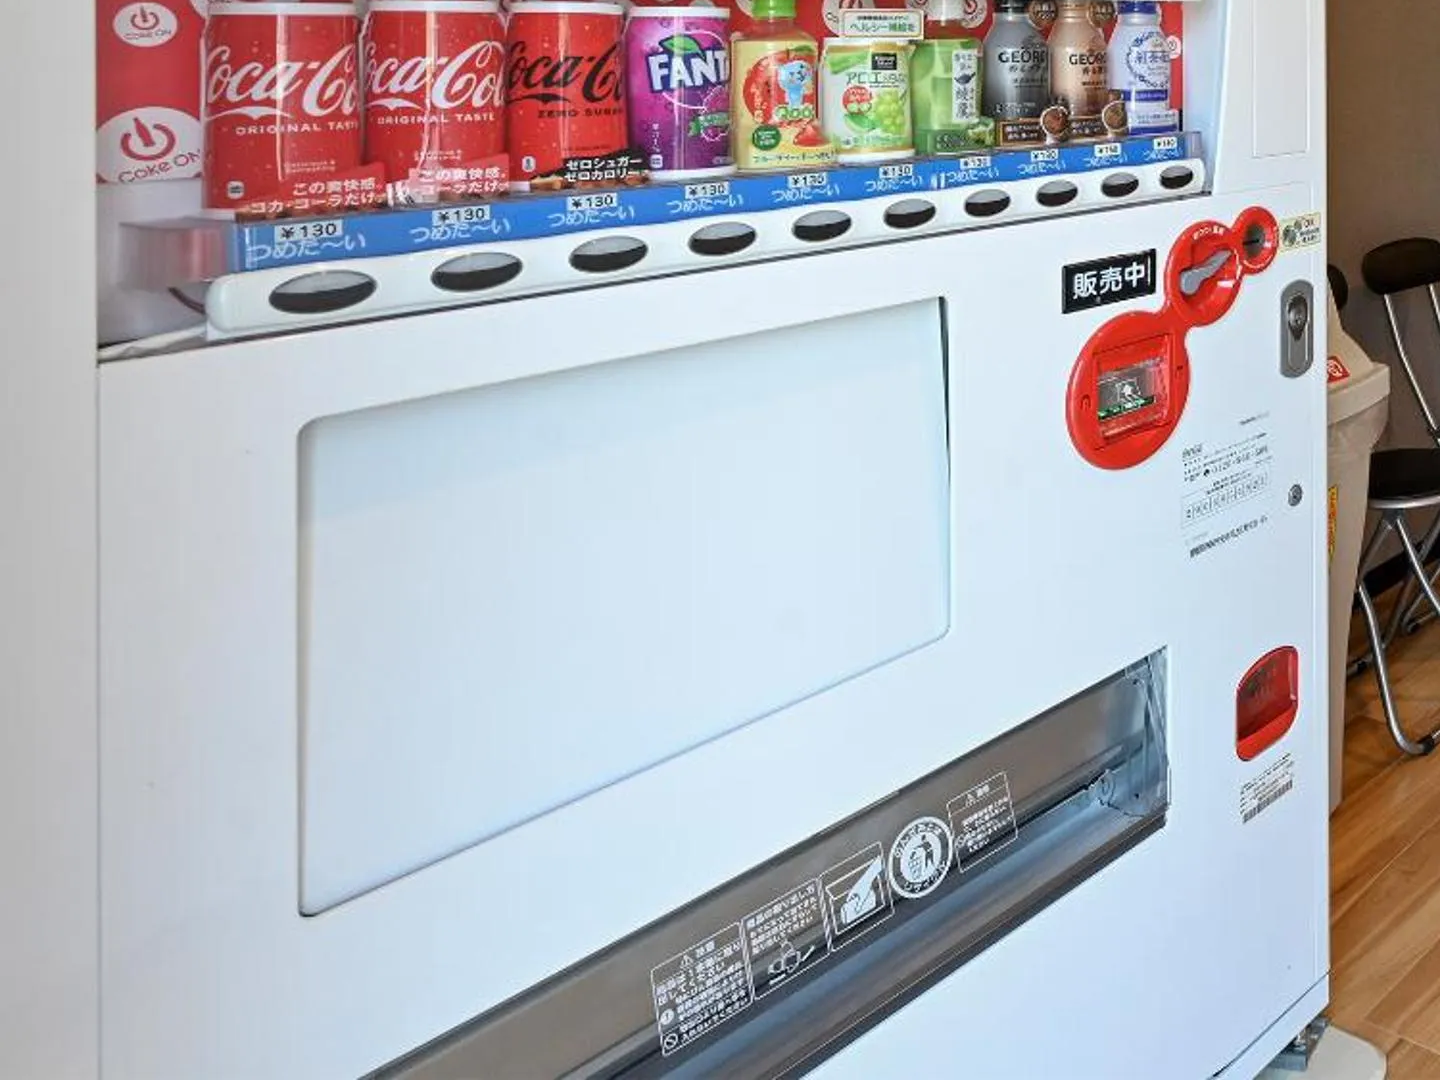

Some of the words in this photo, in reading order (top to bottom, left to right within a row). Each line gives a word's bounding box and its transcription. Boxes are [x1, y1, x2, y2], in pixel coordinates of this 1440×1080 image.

[648, 48, 729, 92] FANT
[566, 156, 643, 171] ゼロシュガー
[571, 195, 614, 210] ¥130
[439, 207, 486, 222] ¥130
[280, 222, 337, 239] ¥130
[1071, 261, 1148, 301] 販売中
